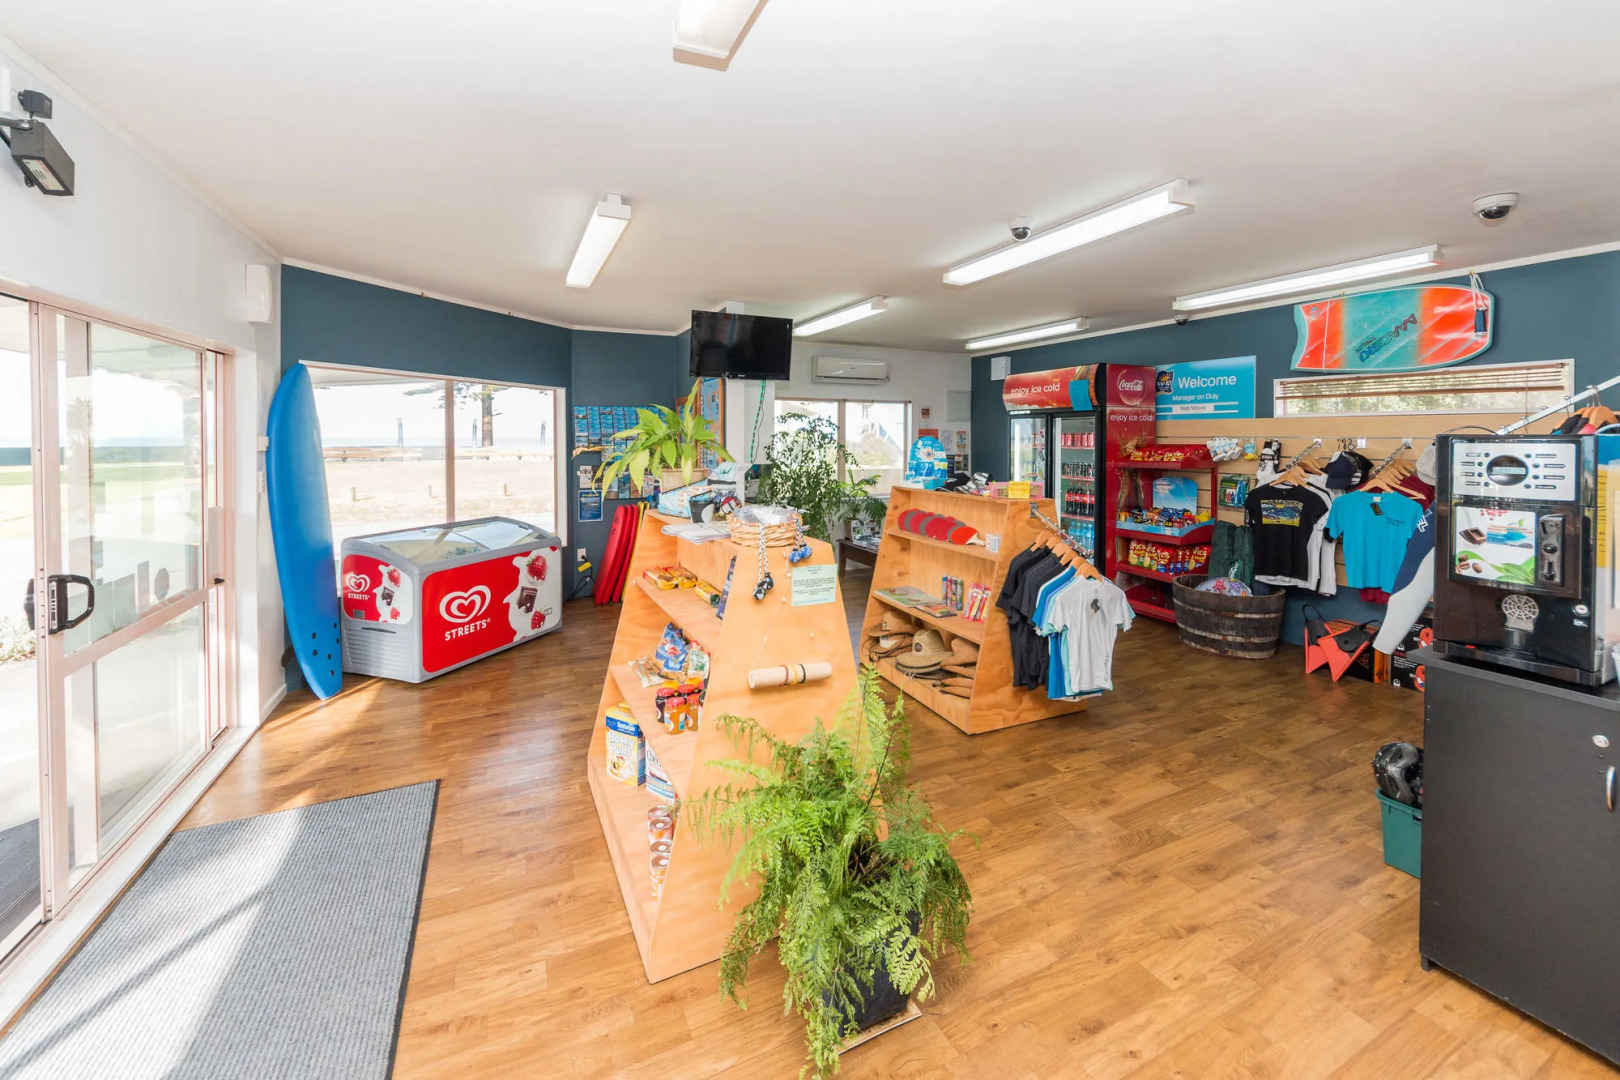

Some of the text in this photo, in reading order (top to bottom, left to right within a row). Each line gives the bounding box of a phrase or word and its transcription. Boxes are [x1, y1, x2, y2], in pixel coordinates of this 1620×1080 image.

[1178, 375, 1237, 389] Welcome
[1011, 383, 1060, 396] enjoy ice cold
[1110, 414, 1127, 422] enjoy
[348, 592, 368, 600] STREETS
[445, 619, 487, 641] STREETS
